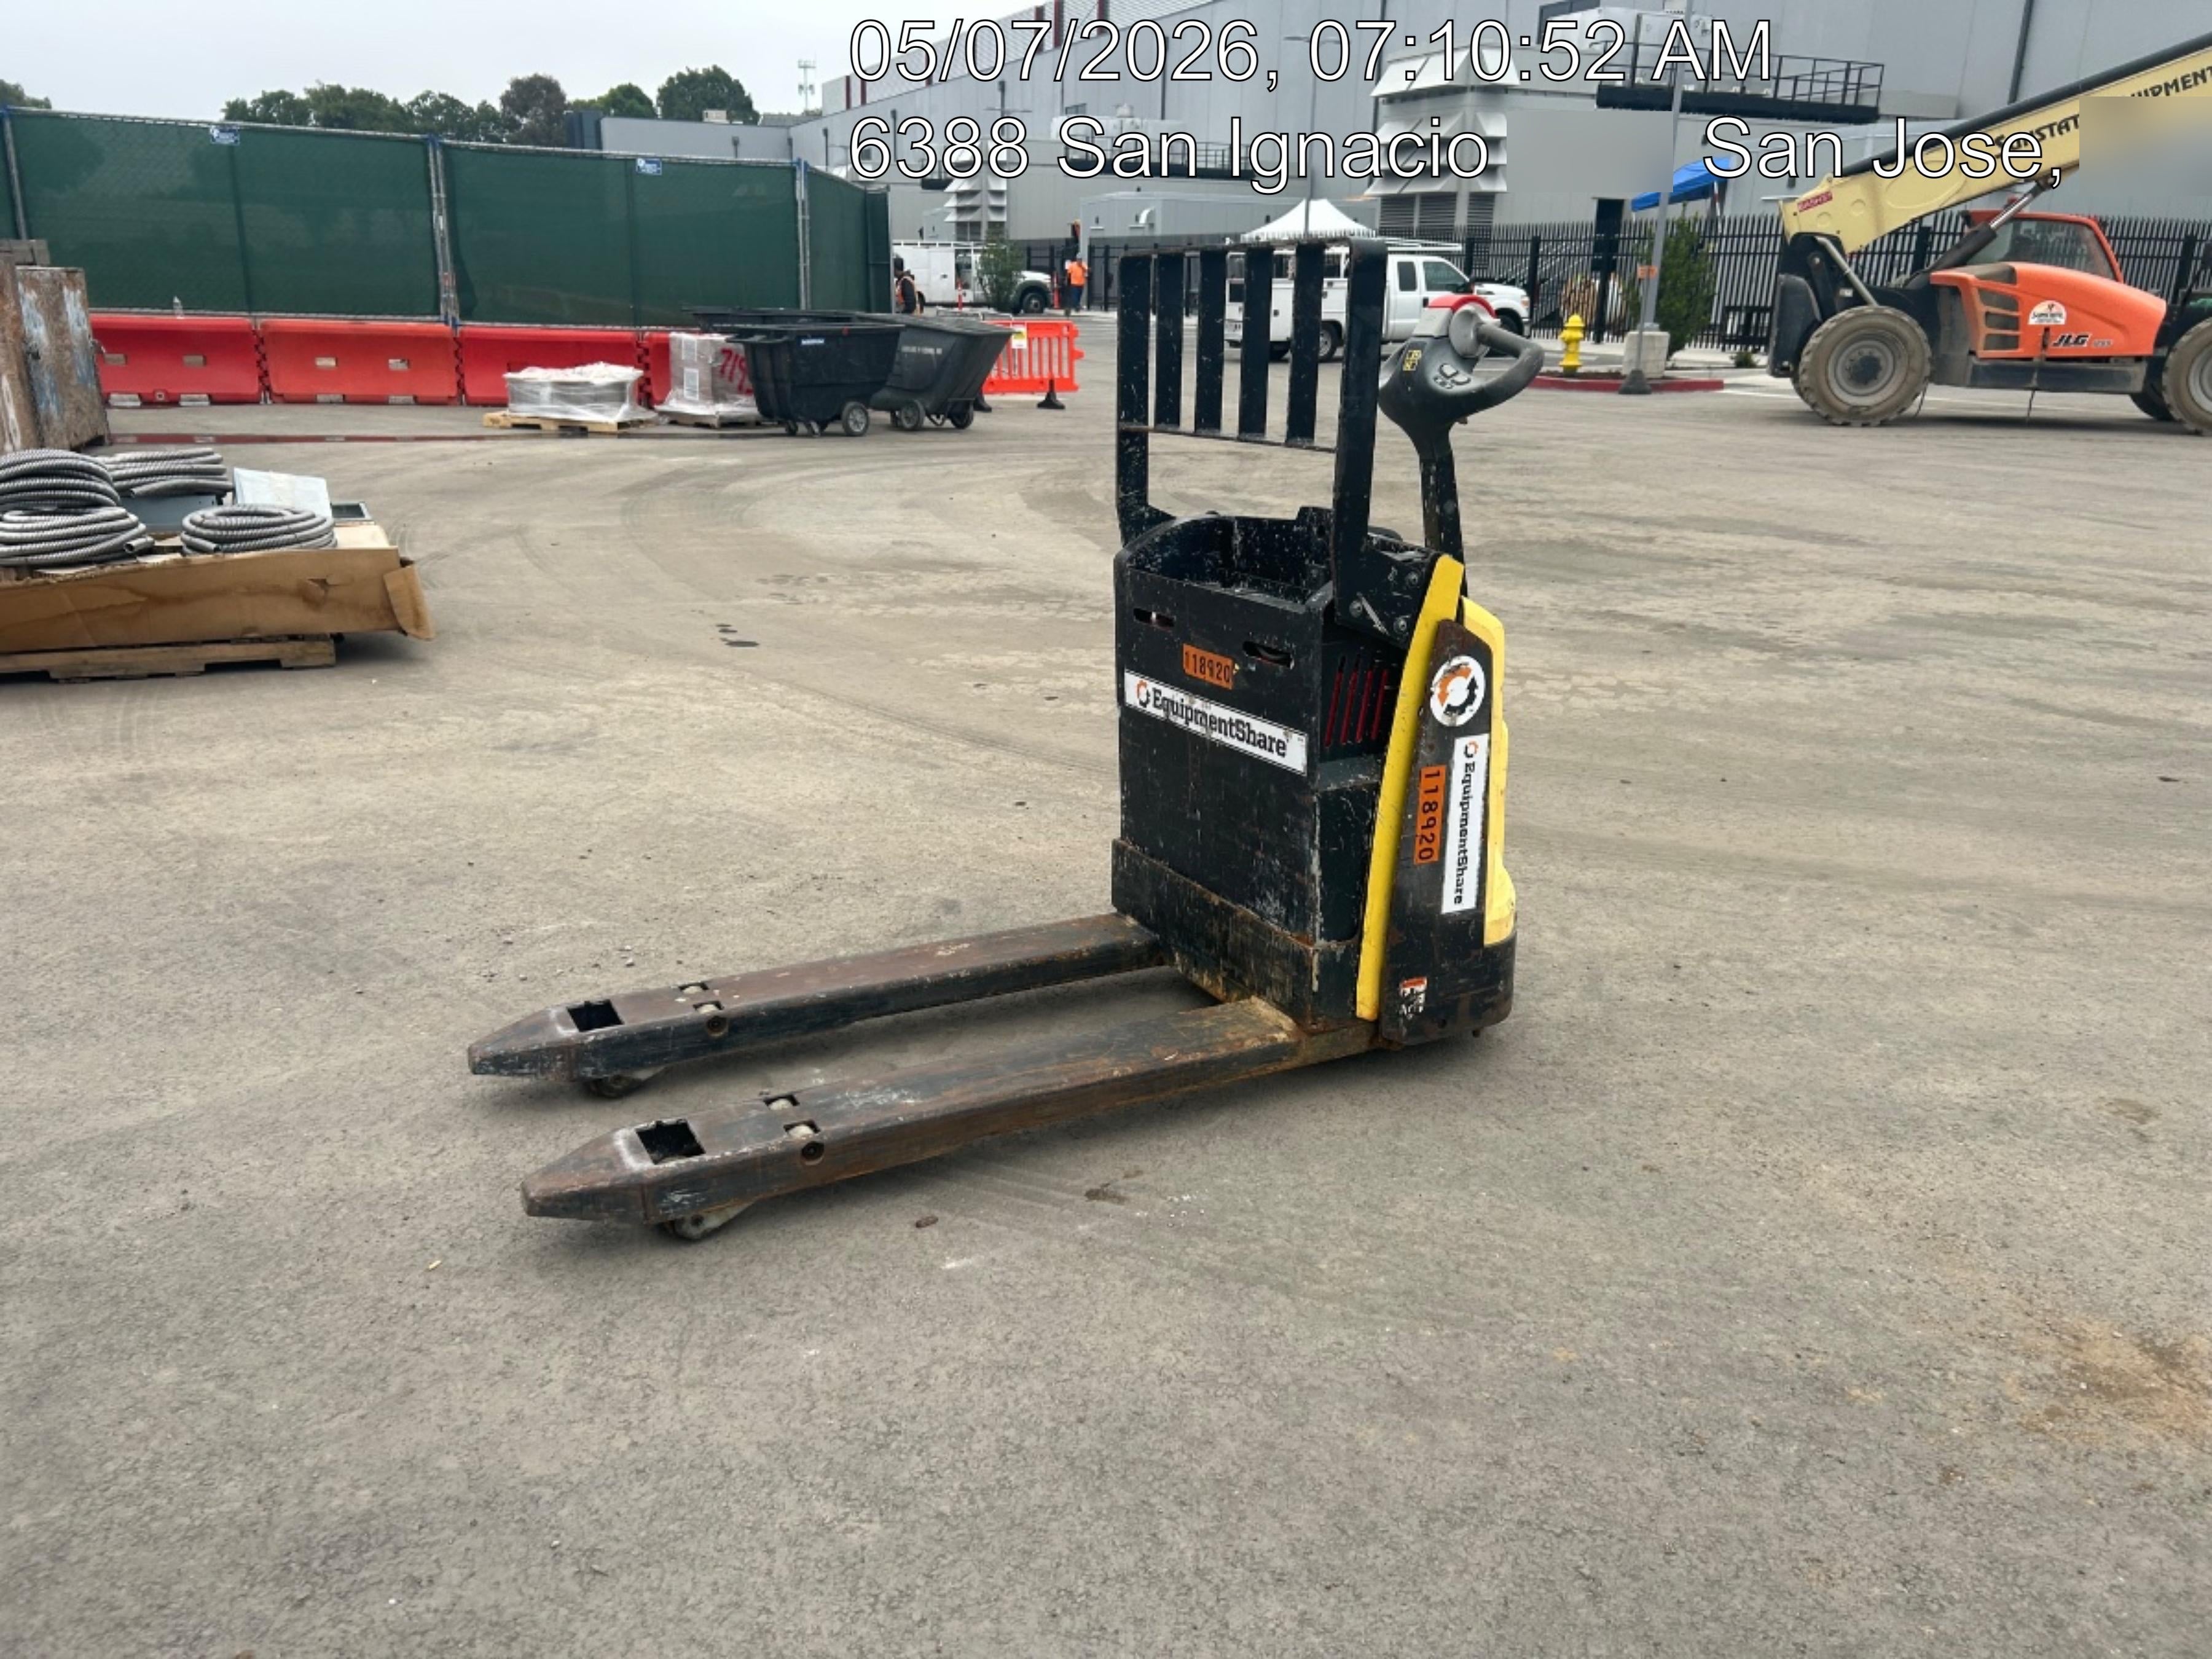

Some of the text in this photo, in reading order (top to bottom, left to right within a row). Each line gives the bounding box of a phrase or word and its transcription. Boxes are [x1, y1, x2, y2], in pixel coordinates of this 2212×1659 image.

[1185, 652, 1230, 683] 118920
[1152, 688, 1287, 758] EquipmentShare
[1418, 770, 1440, 860] 118920
[1454, 761, 1476, 905] EquipmentShare
